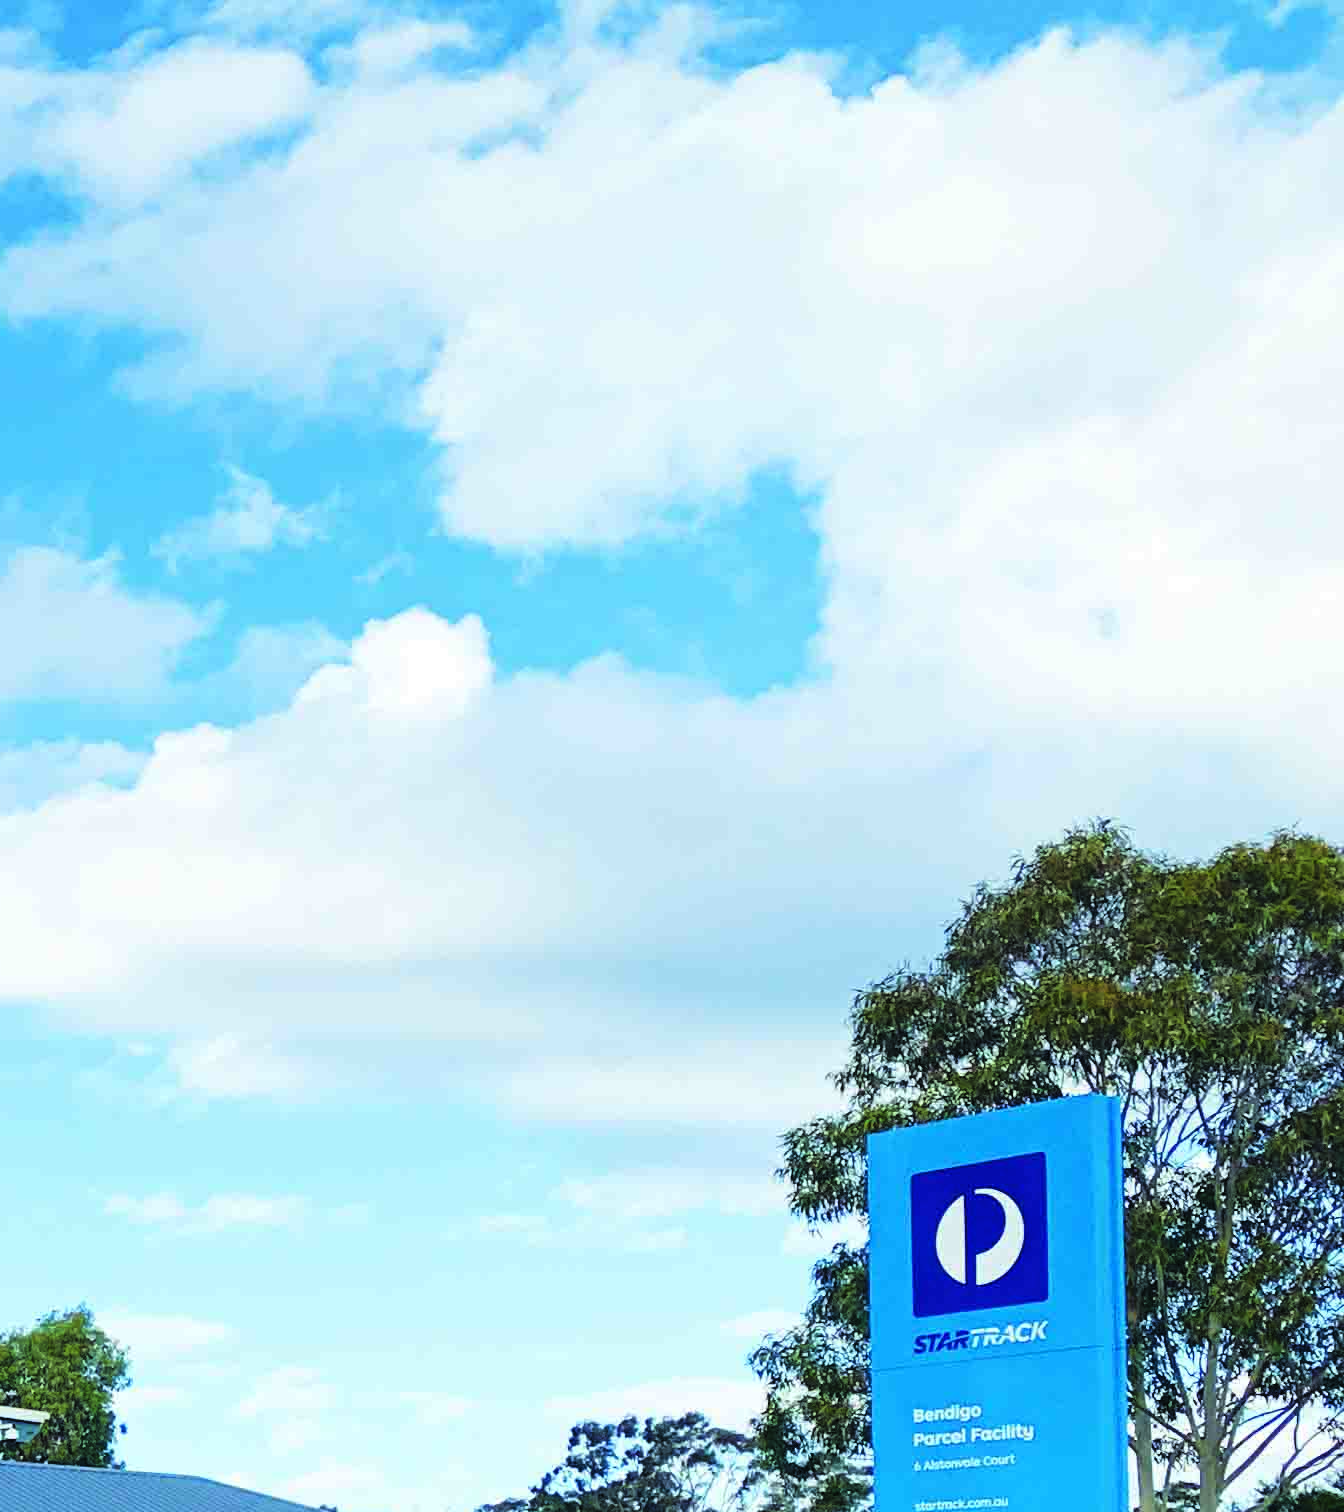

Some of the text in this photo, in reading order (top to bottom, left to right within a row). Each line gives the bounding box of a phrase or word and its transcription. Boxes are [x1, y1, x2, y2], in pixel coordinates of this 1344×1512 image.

[913, 1320, 1049, 1354] STARTRACK
[913, 1404, 982, 1423] Bendigo
[914, 1423, 1034, 1447] Parcel Facility
[914, 1461, 921, 1472] 6
[983, 1453, 1016, 1467] Court
[914, 1497, 1009, 1512] startrack.com.au
